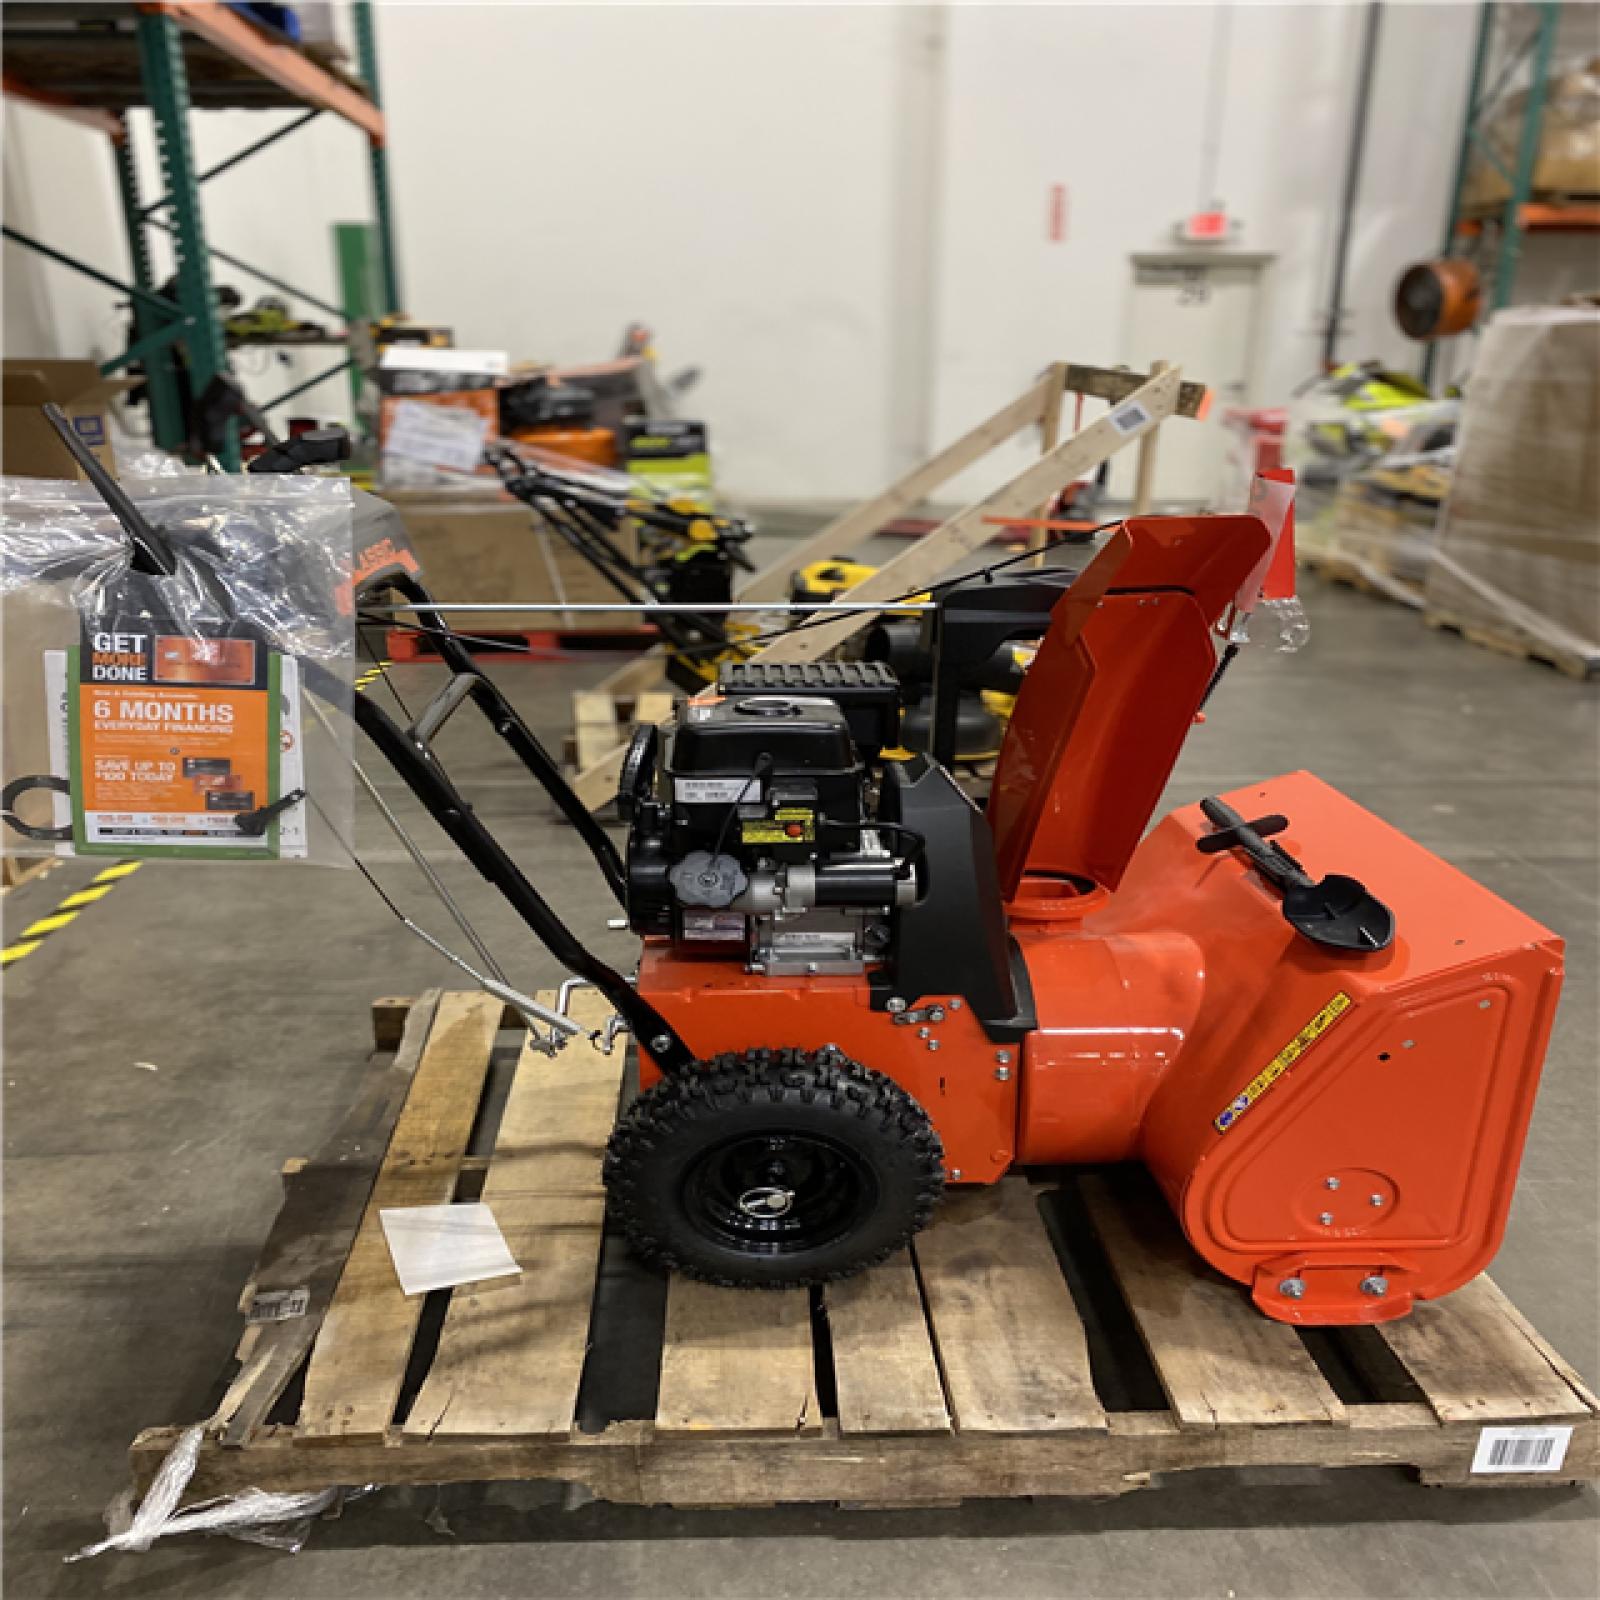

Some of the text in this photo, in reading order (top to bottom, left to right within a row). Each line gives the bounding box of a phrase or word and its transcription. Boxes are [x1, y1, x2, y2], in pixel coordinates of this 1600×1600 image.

[94, 633, 148, 653] GET
[92, 664, 148, 680] DONE
[94, 699, 233, 722] 6 MONTHS
